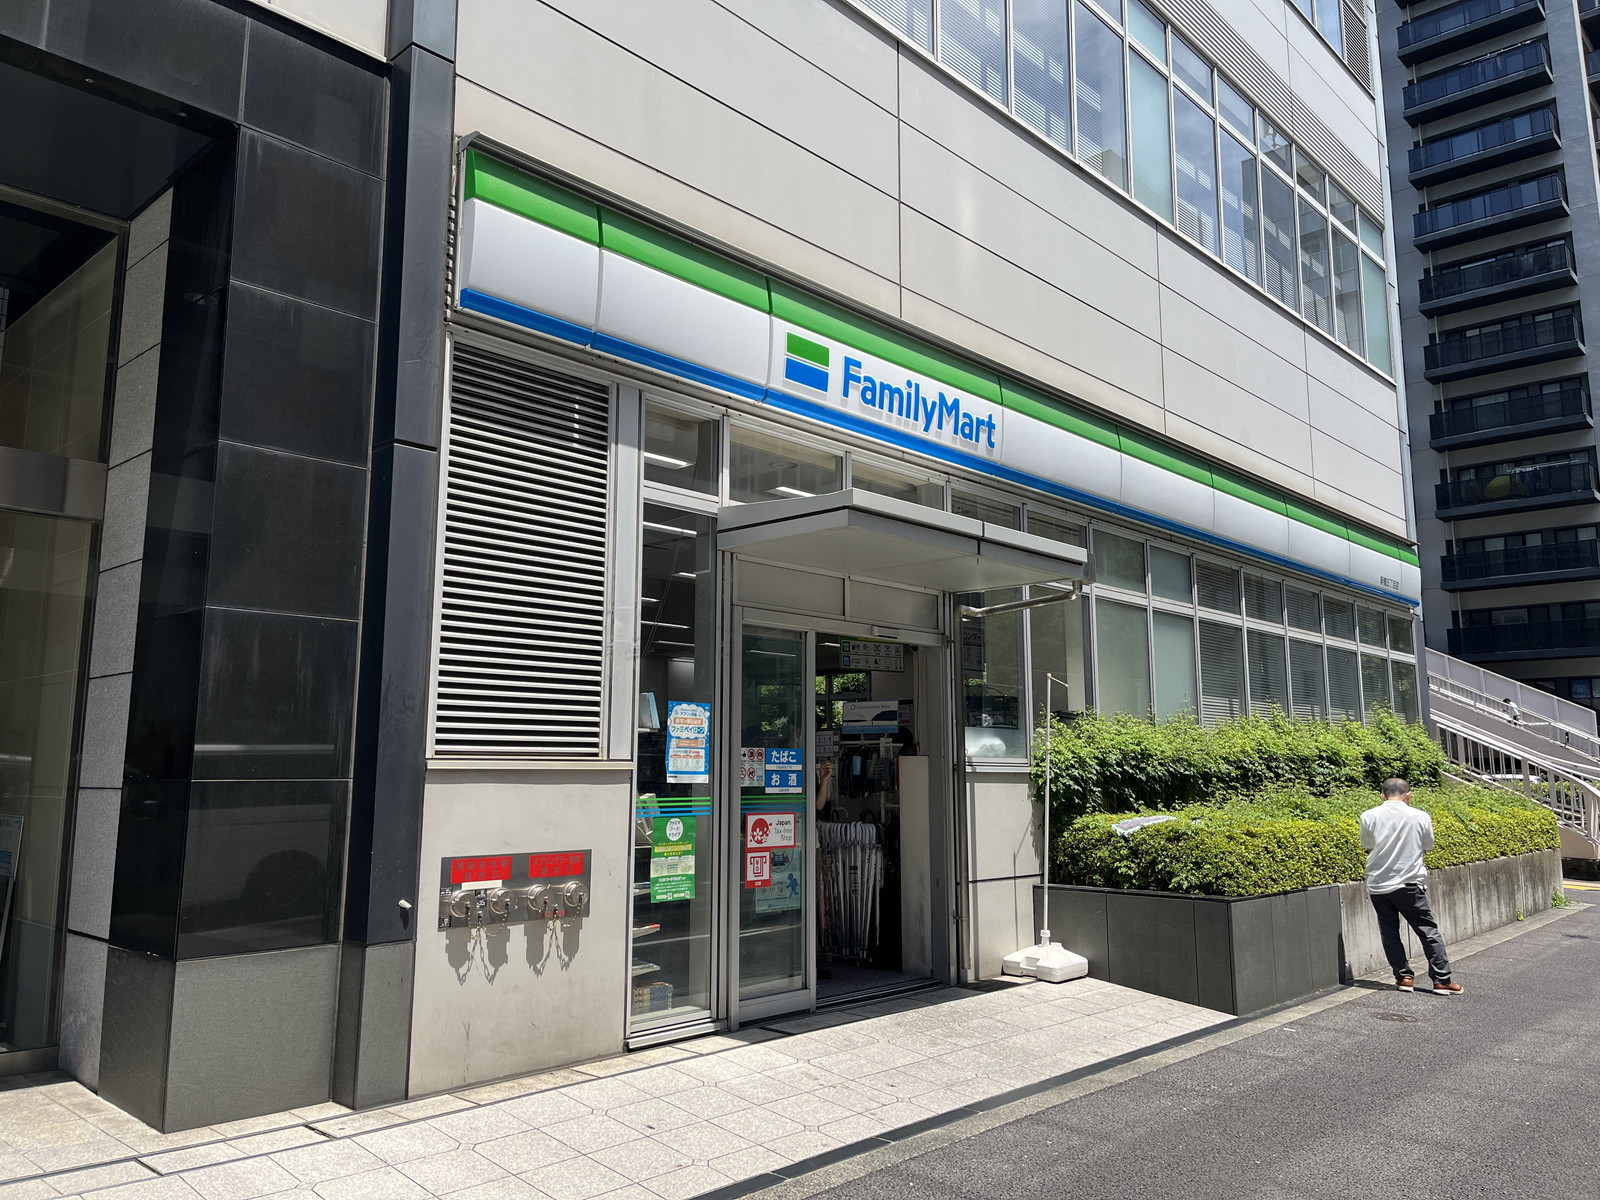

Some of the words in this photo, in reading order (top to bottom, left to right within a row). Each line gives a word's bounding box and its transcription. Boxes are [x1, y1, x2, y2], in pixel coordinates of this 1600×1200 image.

[842, 355, 996, 449] FamilyMart
[671, 726, 704, 734] ファミペイローン
[771, 750, 797, 763] たばこ
[771, 773, 797, 786] お酒
